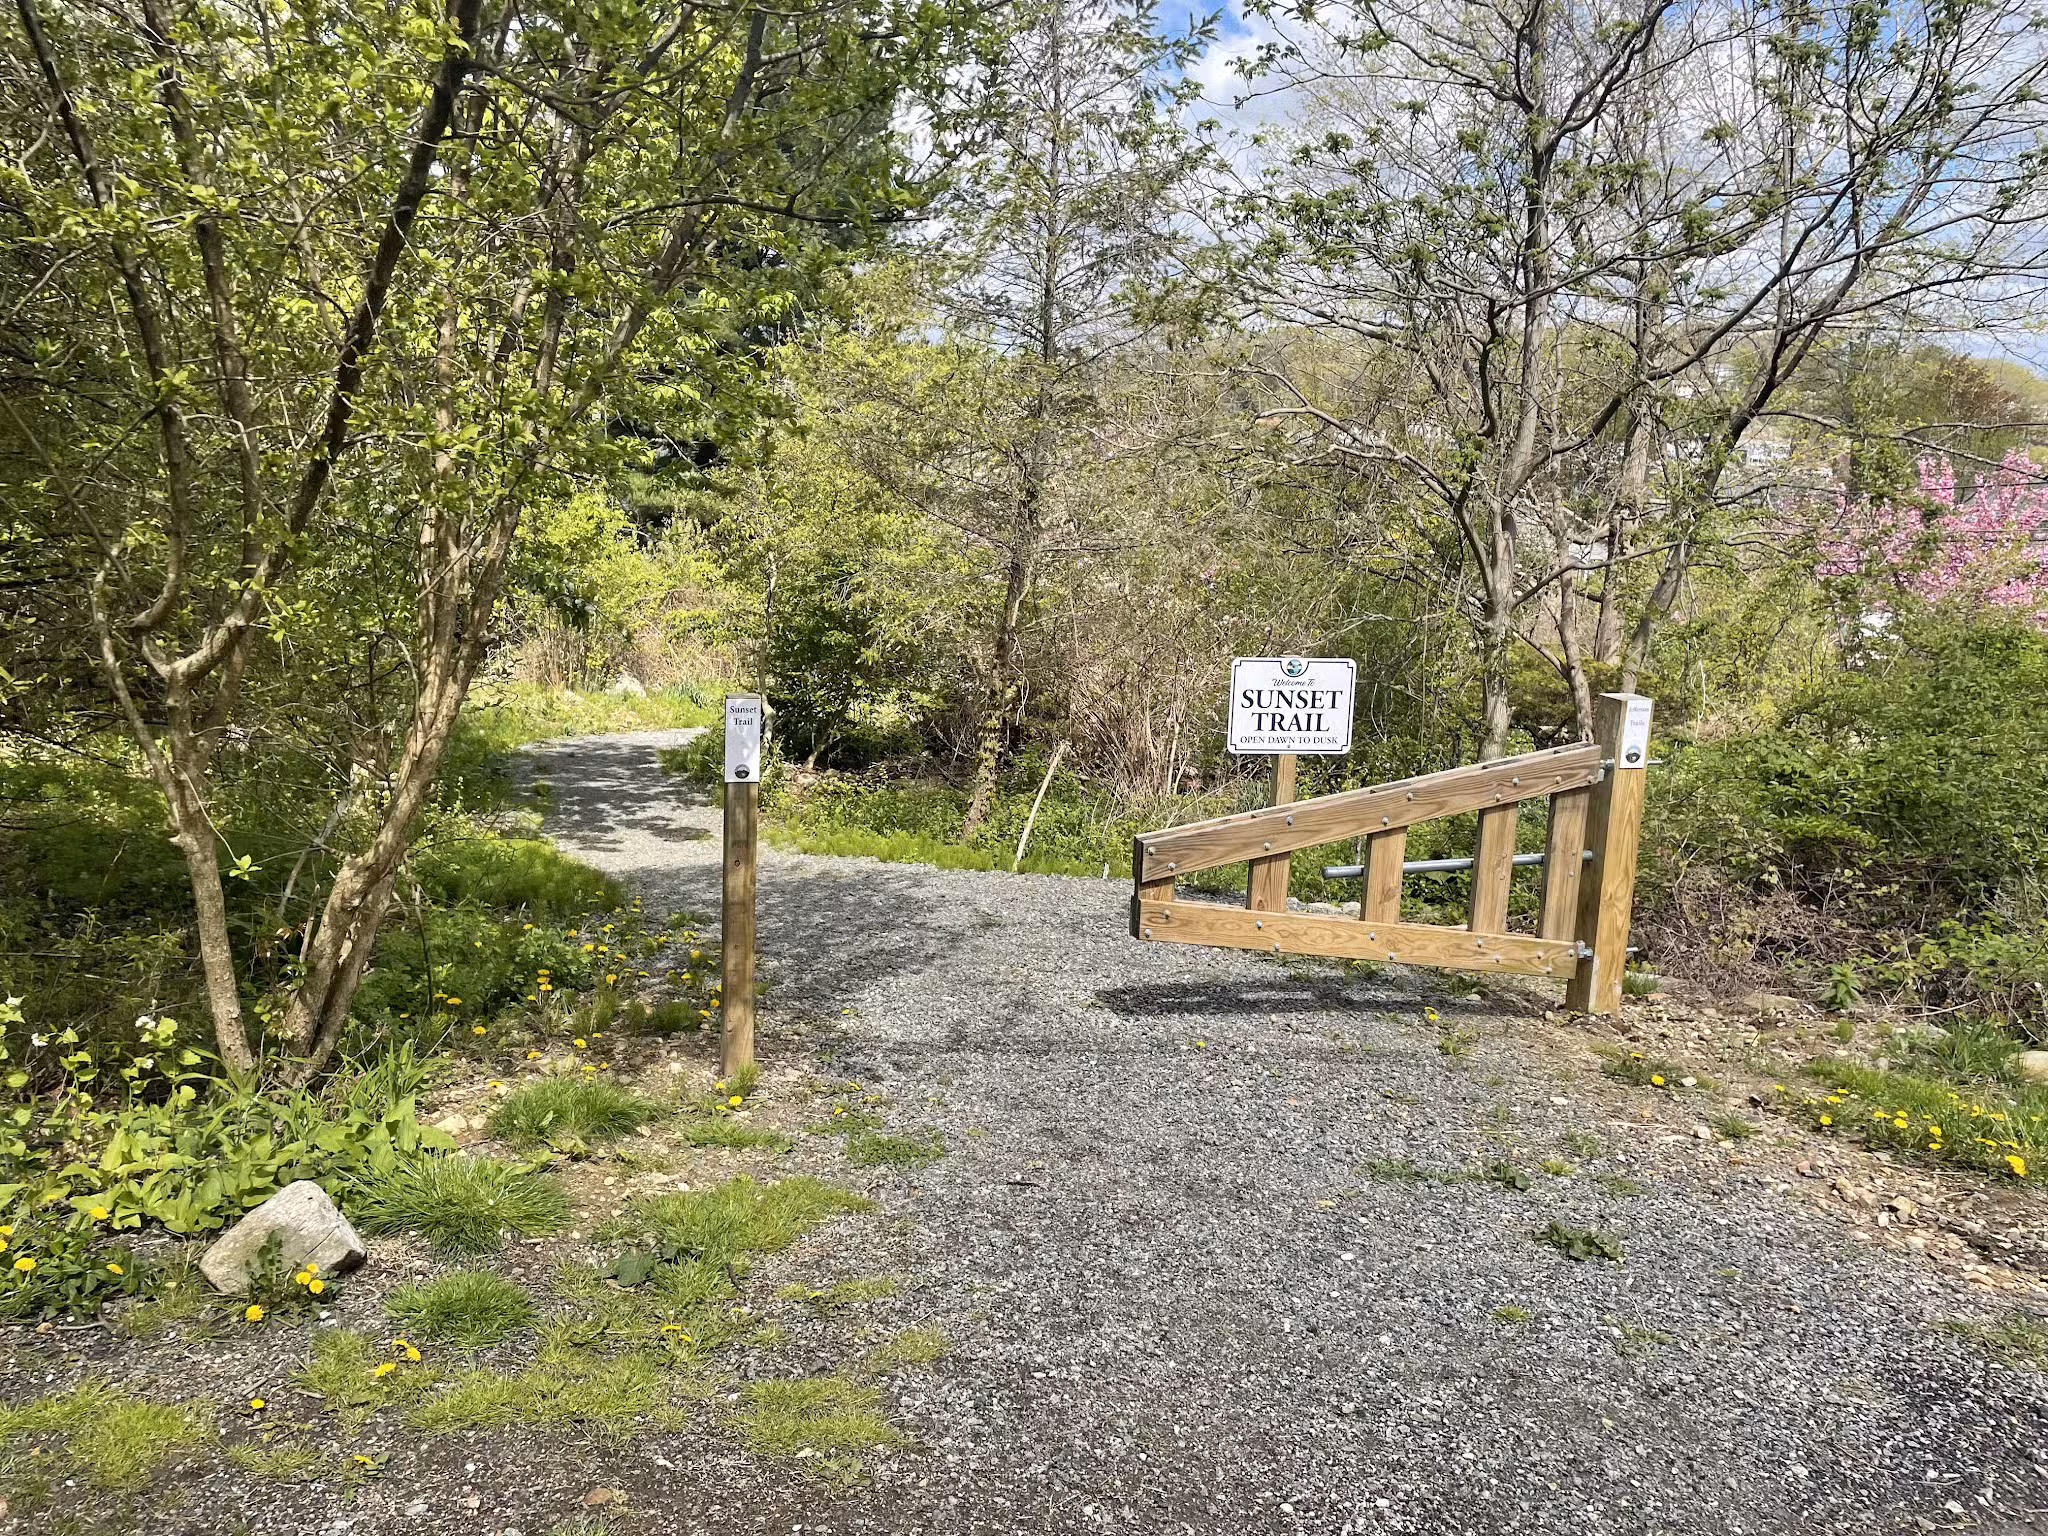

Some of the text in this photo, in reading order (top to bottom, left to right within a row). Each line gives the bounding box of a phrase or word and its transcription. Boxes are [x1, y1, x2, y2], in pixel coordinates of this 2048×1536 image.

[1272, 679, 1305, 687] Welcome
[1241, 689, 1343, 709] SUNSET
[729, 705, 757, 713] Sunset
[733, 717, 753, 725] Trail
[1251, 712, 1330, 732] TRAIL
[1240, 736, 1339, 744] OPEN DAWN TO DUSK
